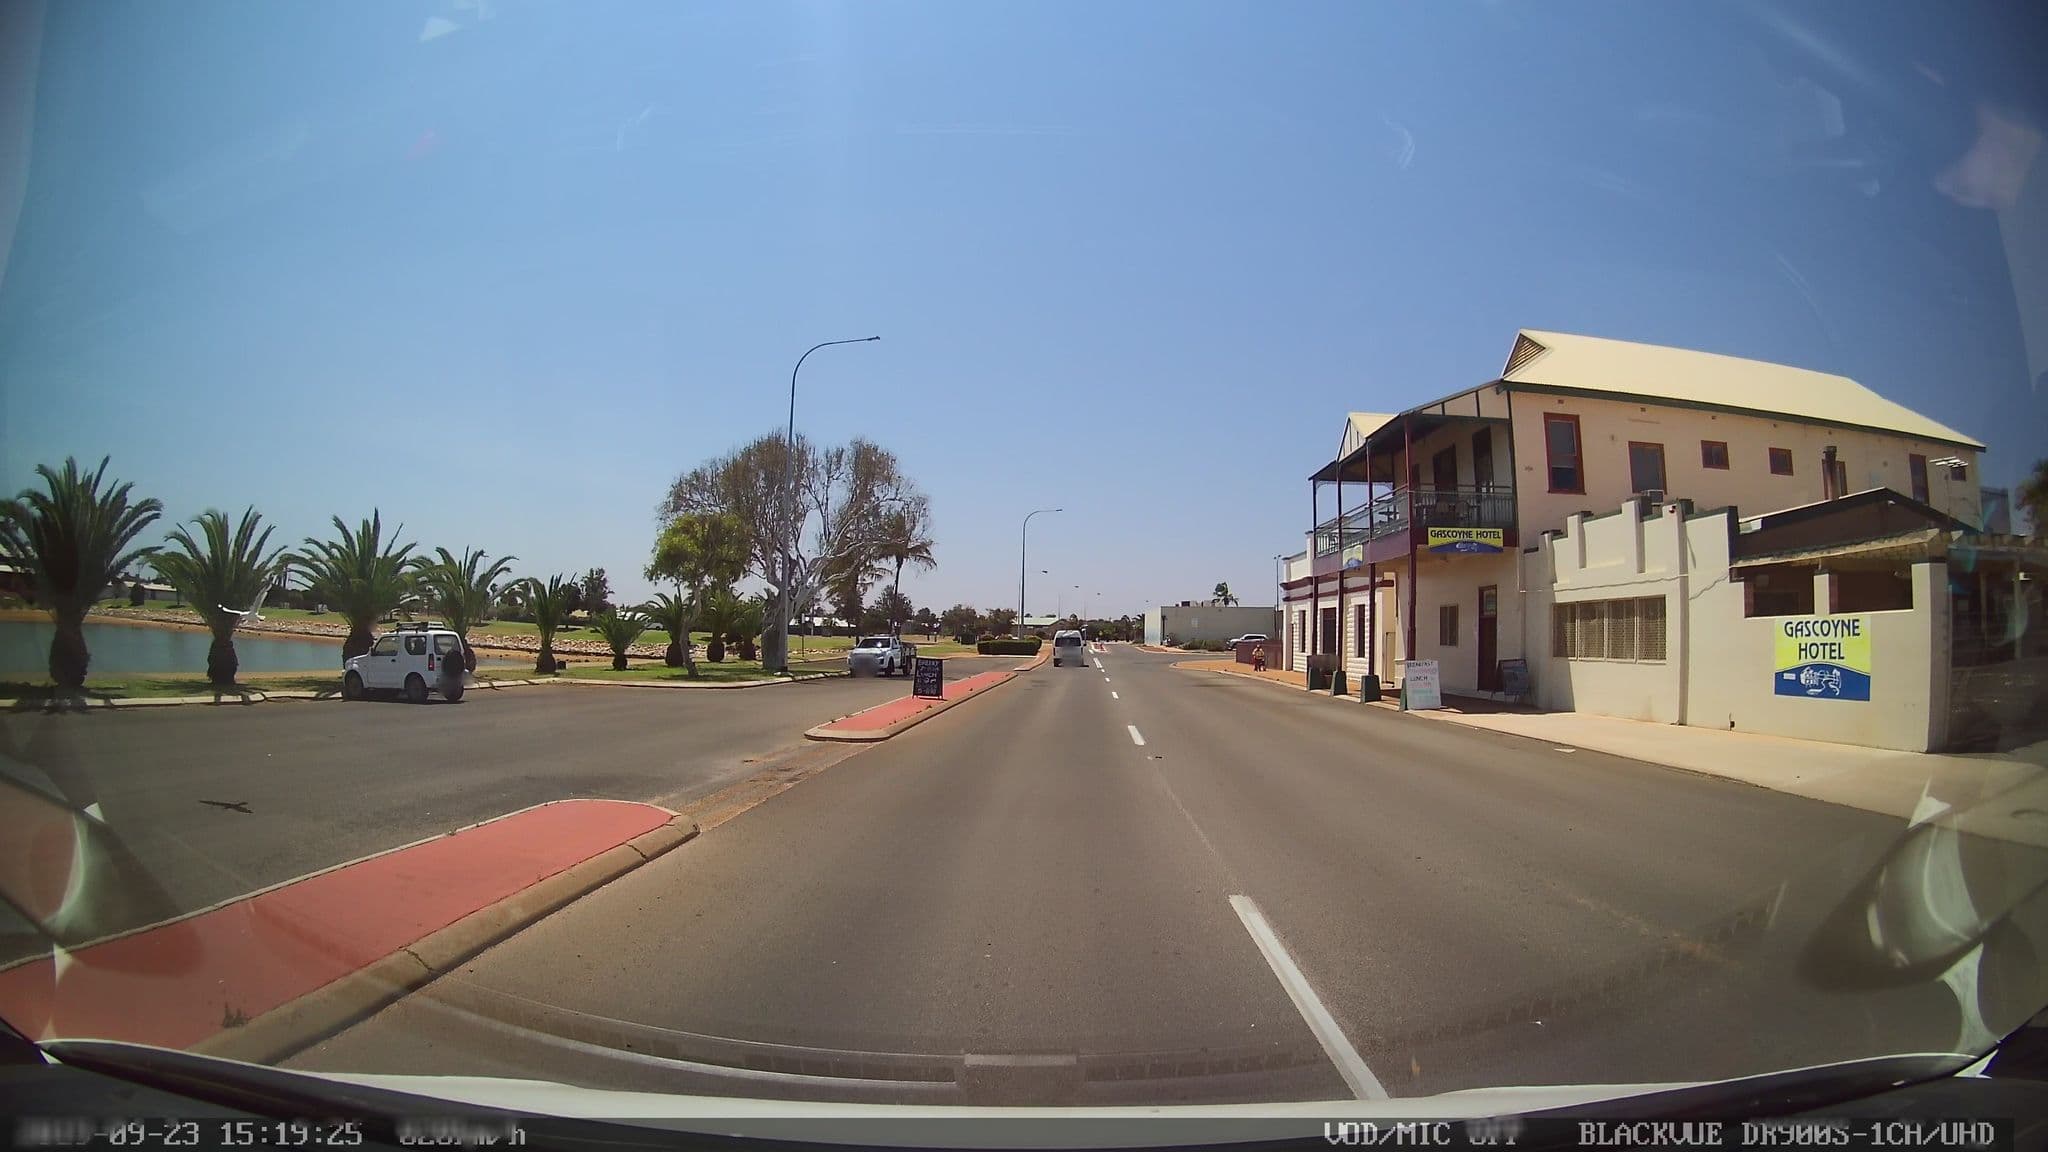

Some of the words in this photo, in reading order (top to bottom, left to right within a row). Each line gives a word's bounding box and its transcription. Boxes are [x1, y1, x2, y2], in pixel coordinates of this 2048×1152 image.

[1430, 529, 1472, 539] GASCOYNE
[1475, 530, 1502, 539] HOTEL
[1784, 619, 1861, 638] GASCOYNE
[1798, 642, 1845, 660] HOTEL
